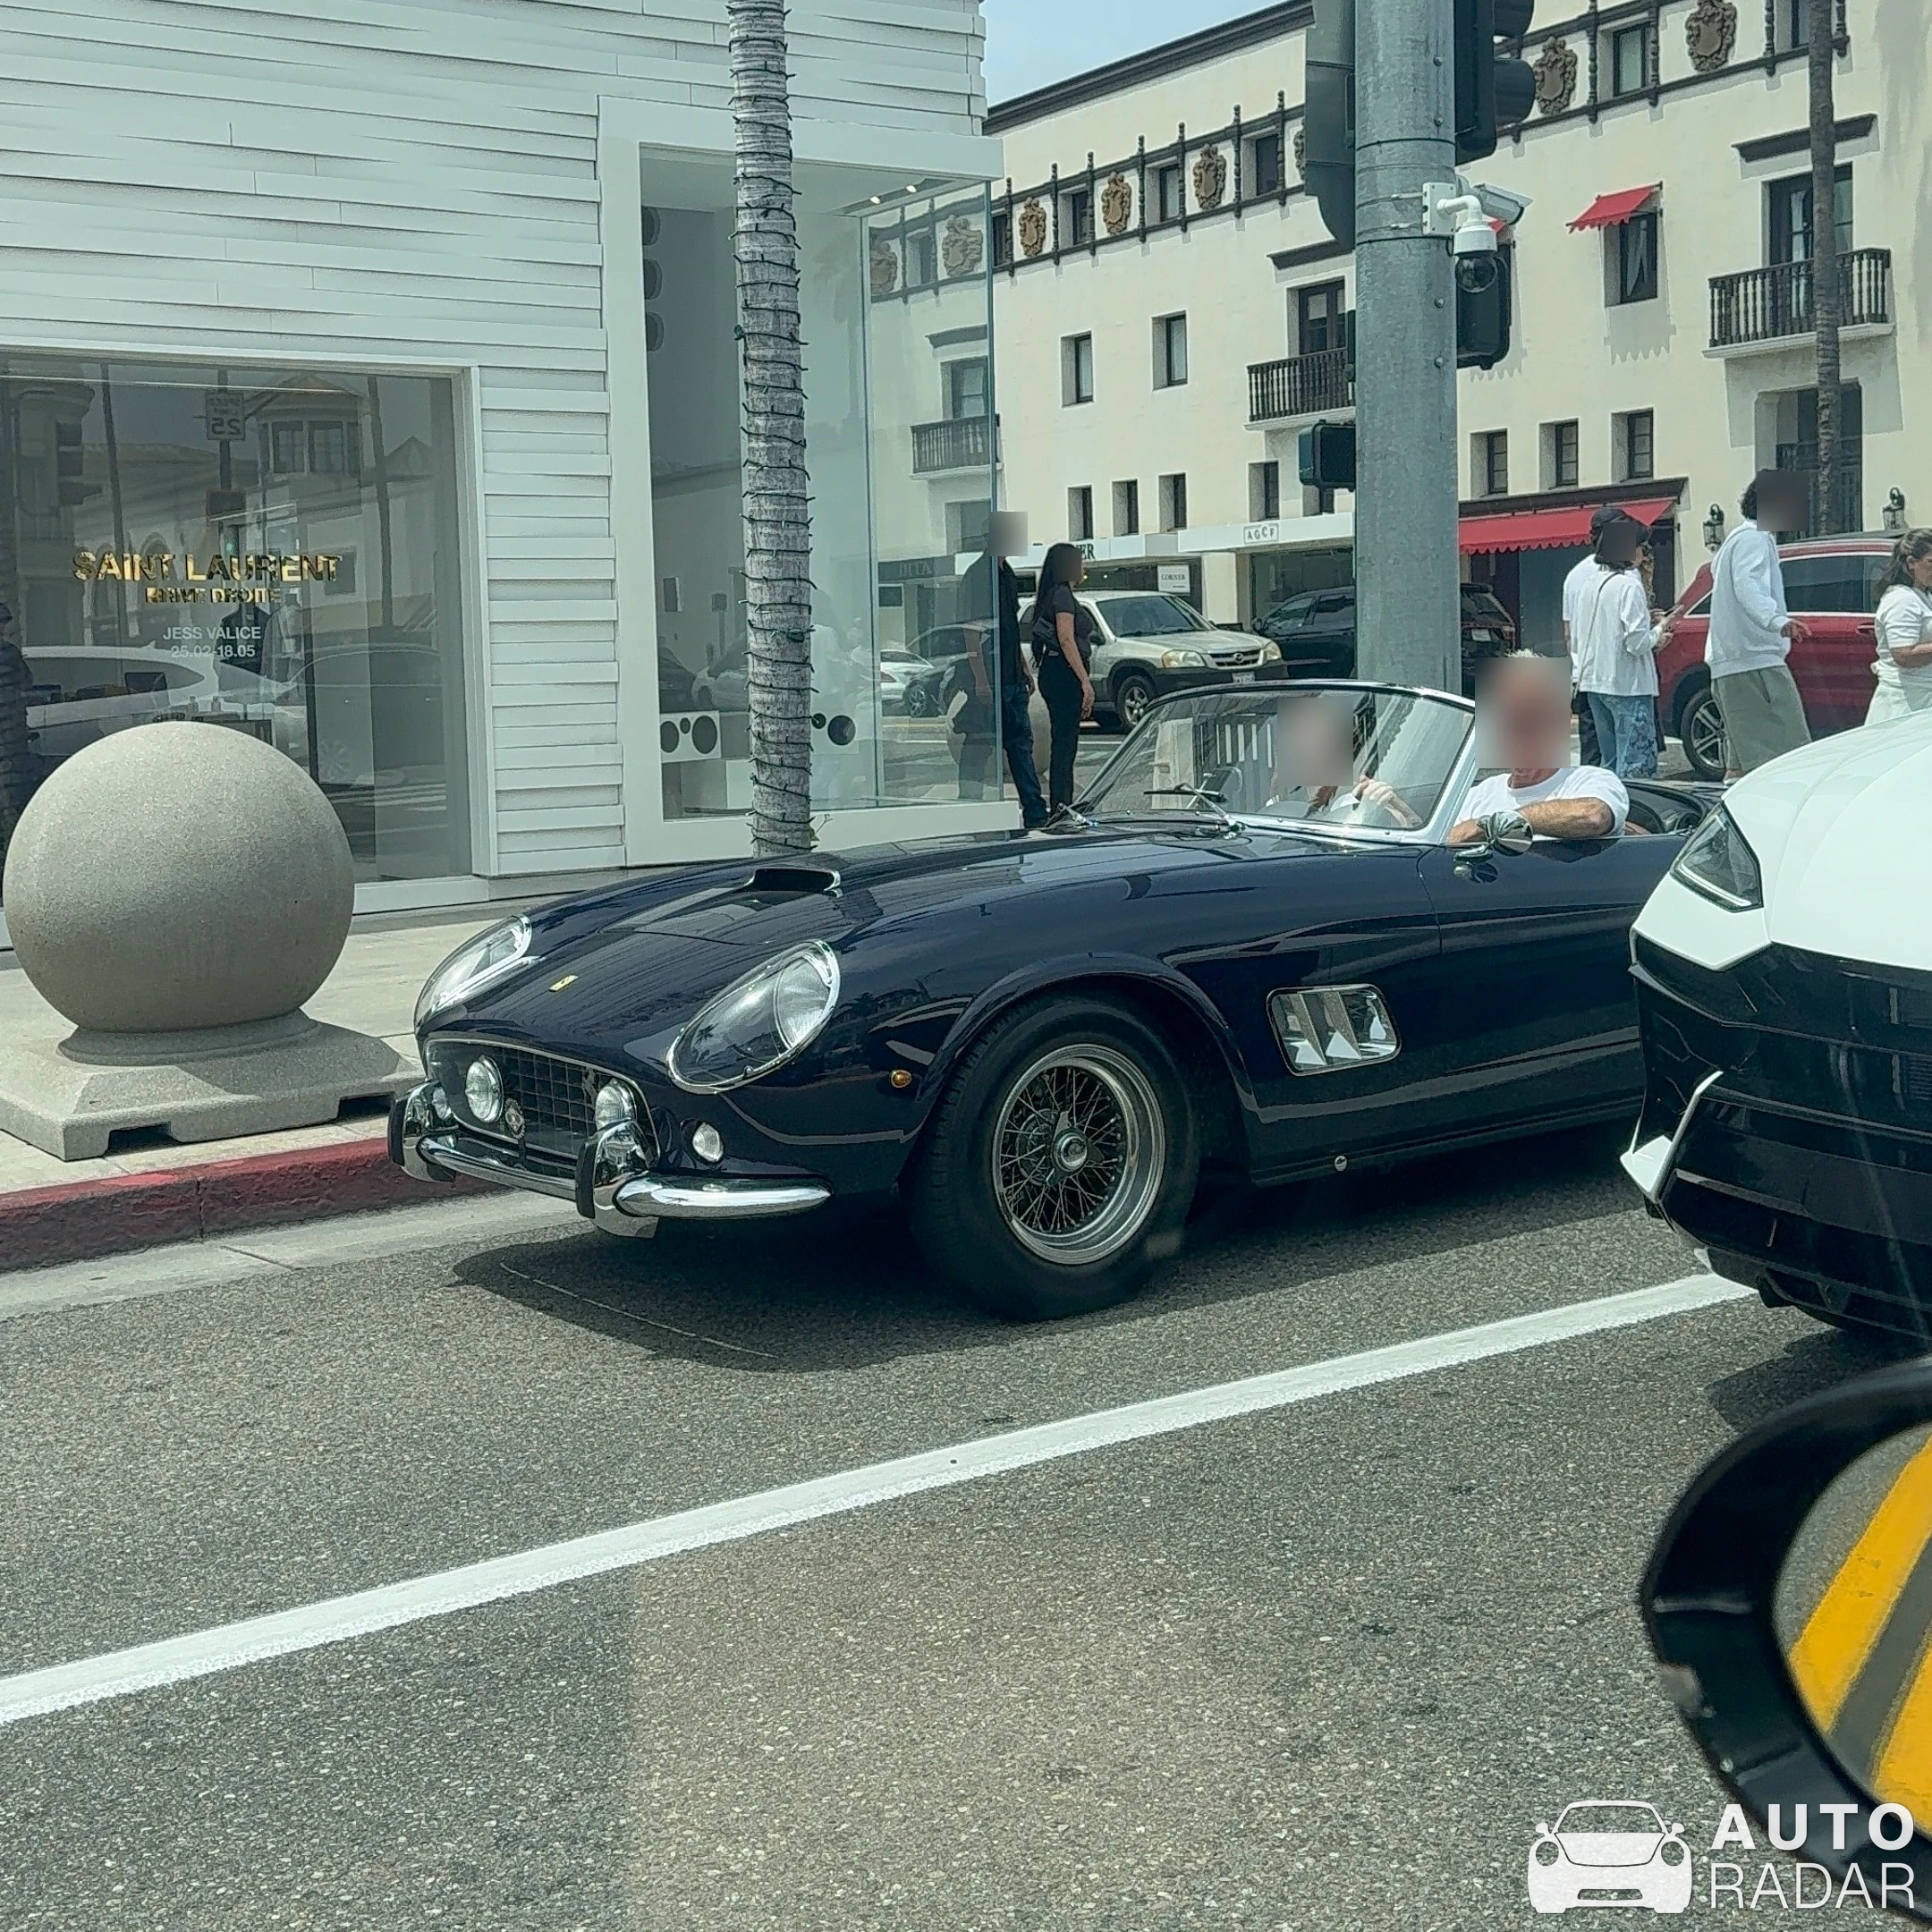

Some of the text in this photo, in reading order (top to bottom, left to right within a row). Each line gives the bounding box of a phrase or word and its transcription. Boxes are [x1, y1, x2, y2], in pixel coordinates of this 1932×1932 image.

[73, 549, 343, 581] SAINT LAURENT
[210, 588, 283, 603] DROITE
[163, 626, 261, 640] JESS VALICE
[170, 645, 256, 657] 25.02-18.05
